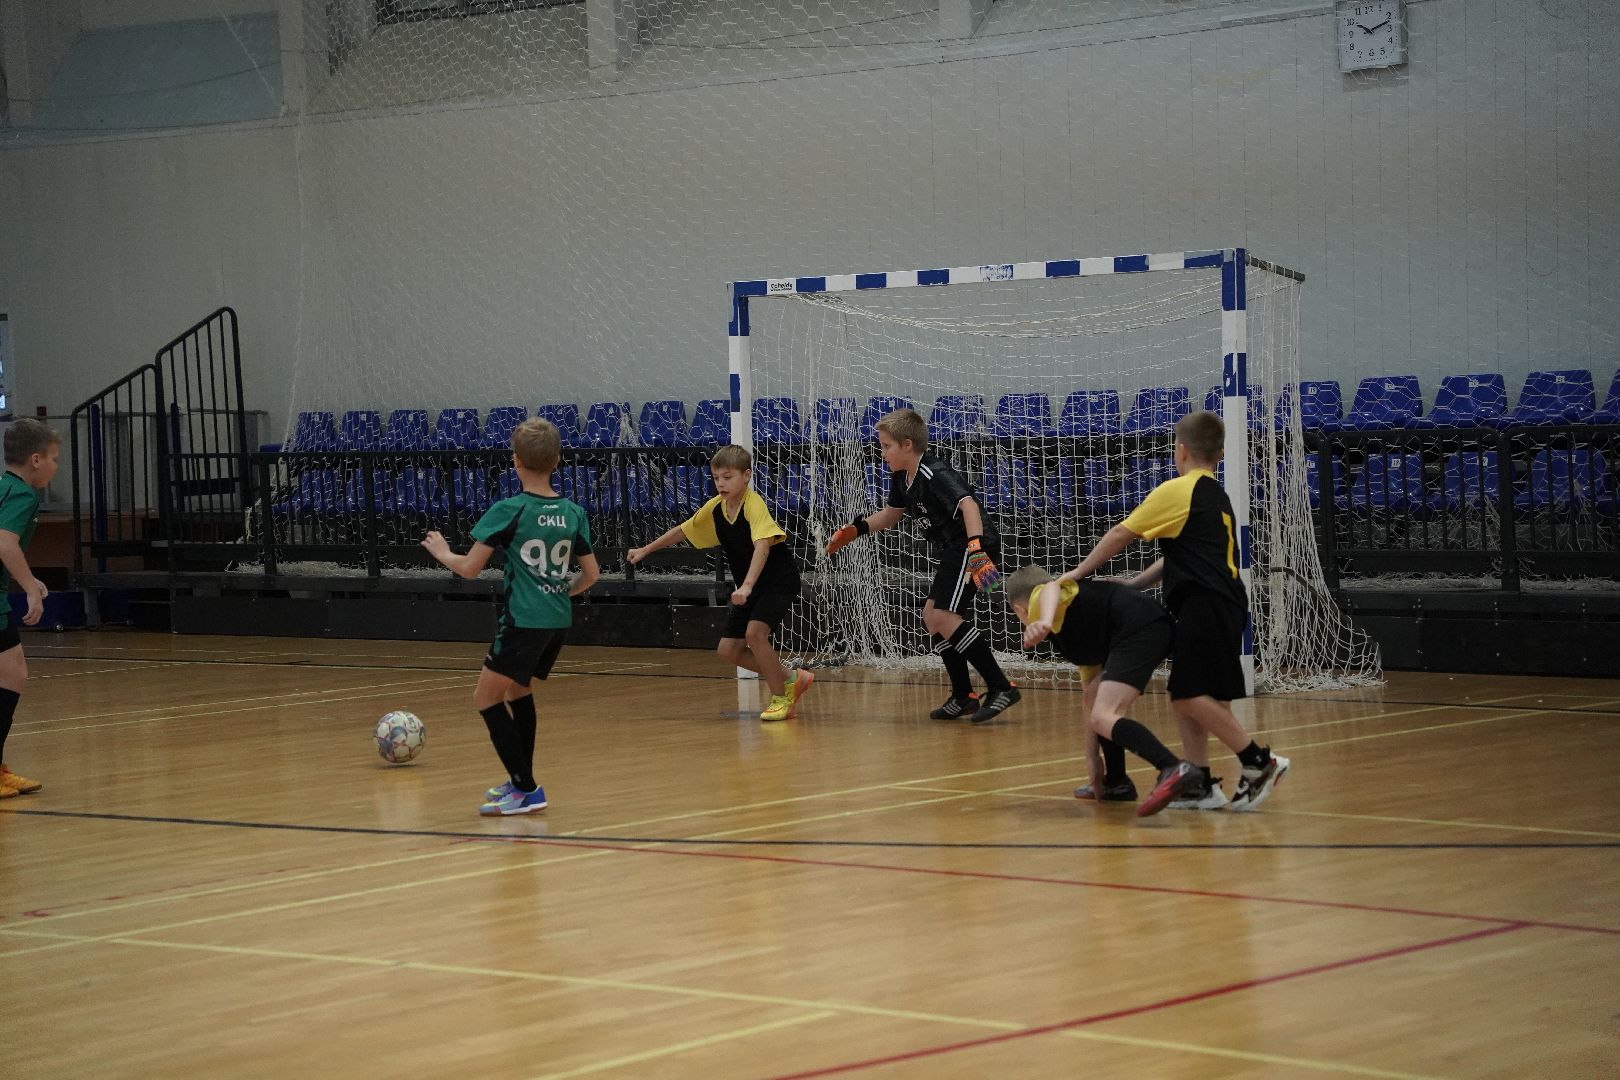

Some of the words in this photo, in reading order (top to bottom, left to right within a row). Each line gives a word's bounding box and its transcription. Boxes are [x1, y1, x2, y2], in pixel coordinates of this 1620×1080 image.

[1365, 6, 1373, 14] 12
[1346, 18, 1354, 26] 10
[537, 515, 567, 528] СКЦ
[520, 539, 572, 580] 99
